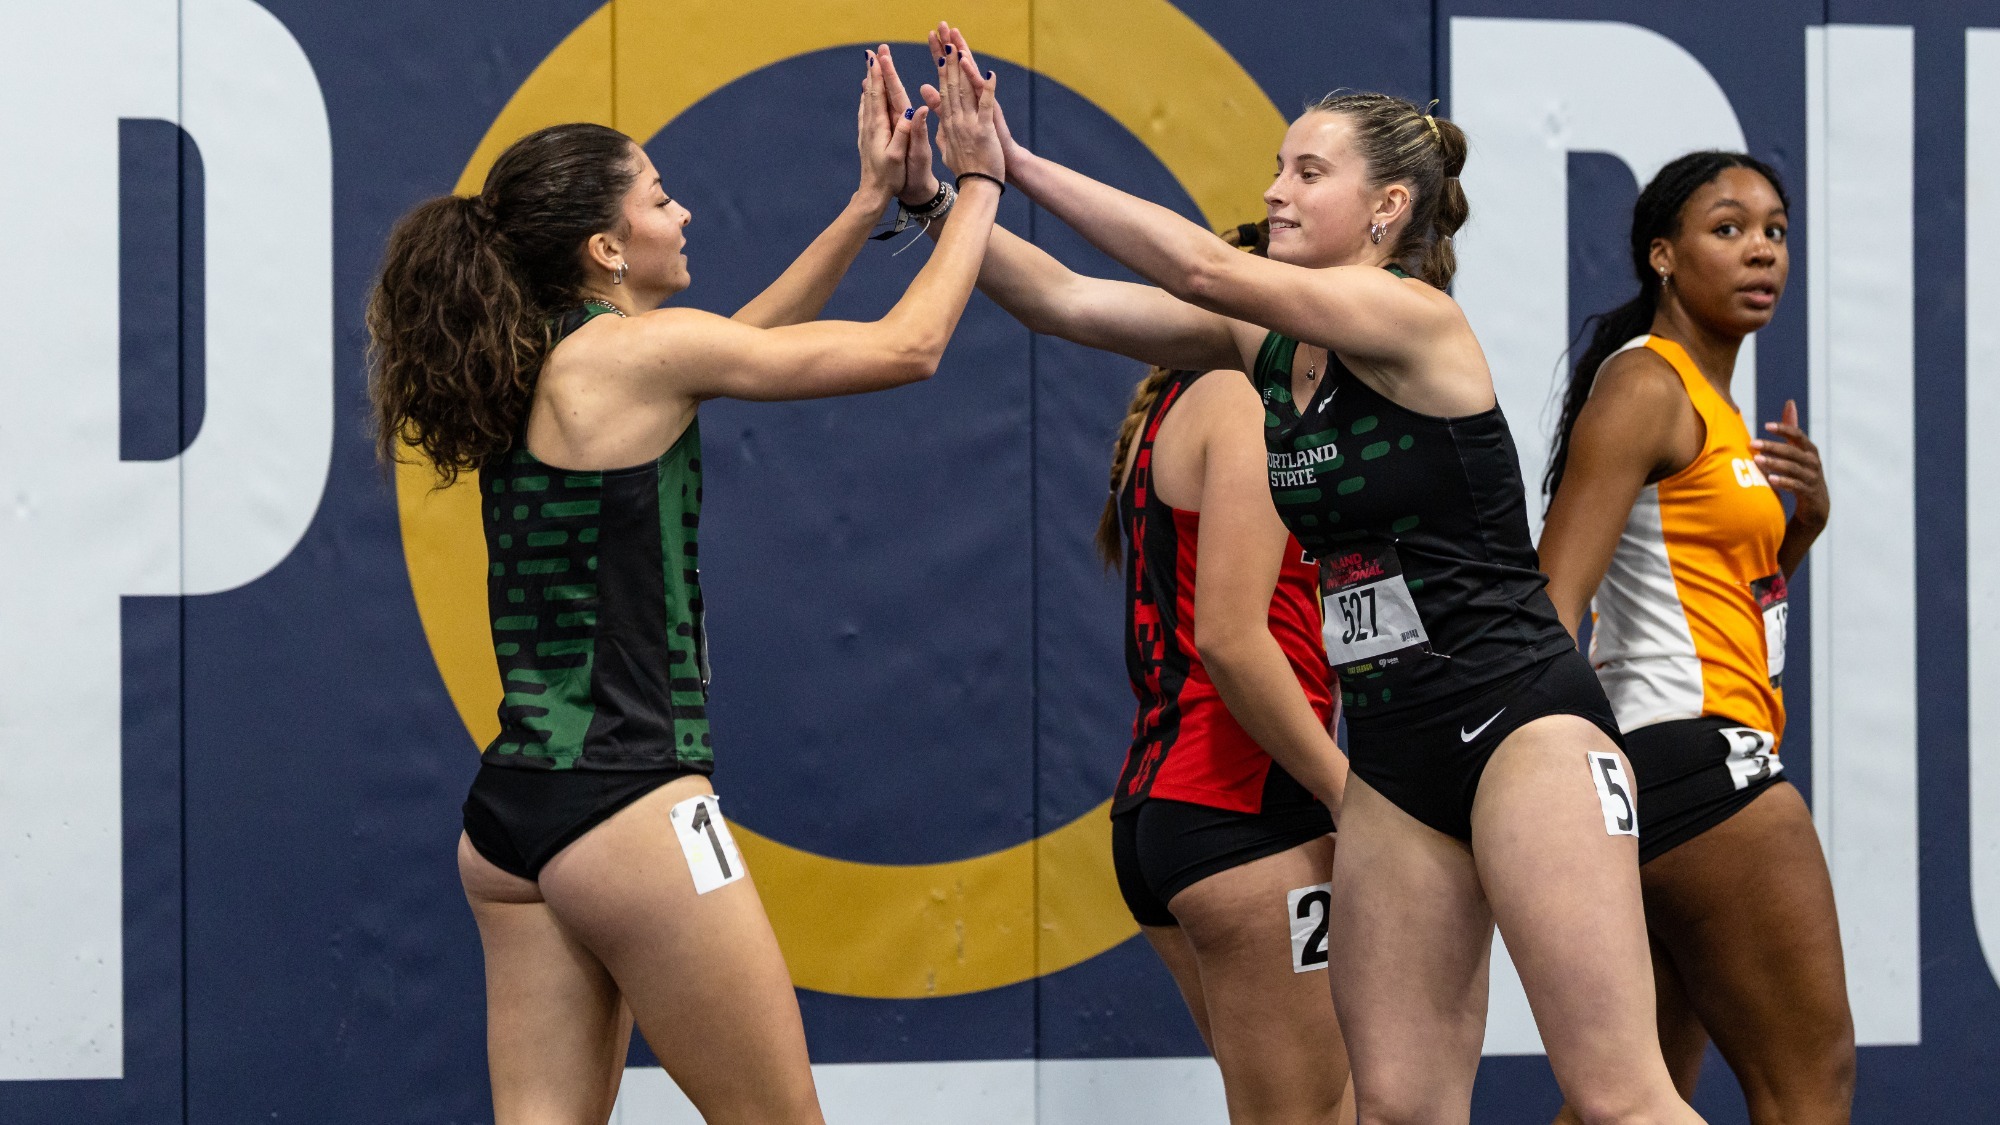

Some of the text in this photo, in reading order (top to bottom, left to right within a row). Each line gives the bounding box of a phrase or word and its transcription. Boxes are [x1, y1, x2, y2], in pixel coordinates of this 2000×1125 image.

[1267, 443, 1338, 469] ORTLAND
[1270, 467, 1317, 487] STATE
[1338, 587, 1379, 645] 527
[1735, 731, 1771, 786] 3
[1597, 758, 1633, 831] 5
[691, 801, 732, 880] 1
[1297, 890, 1331, 966] 2
